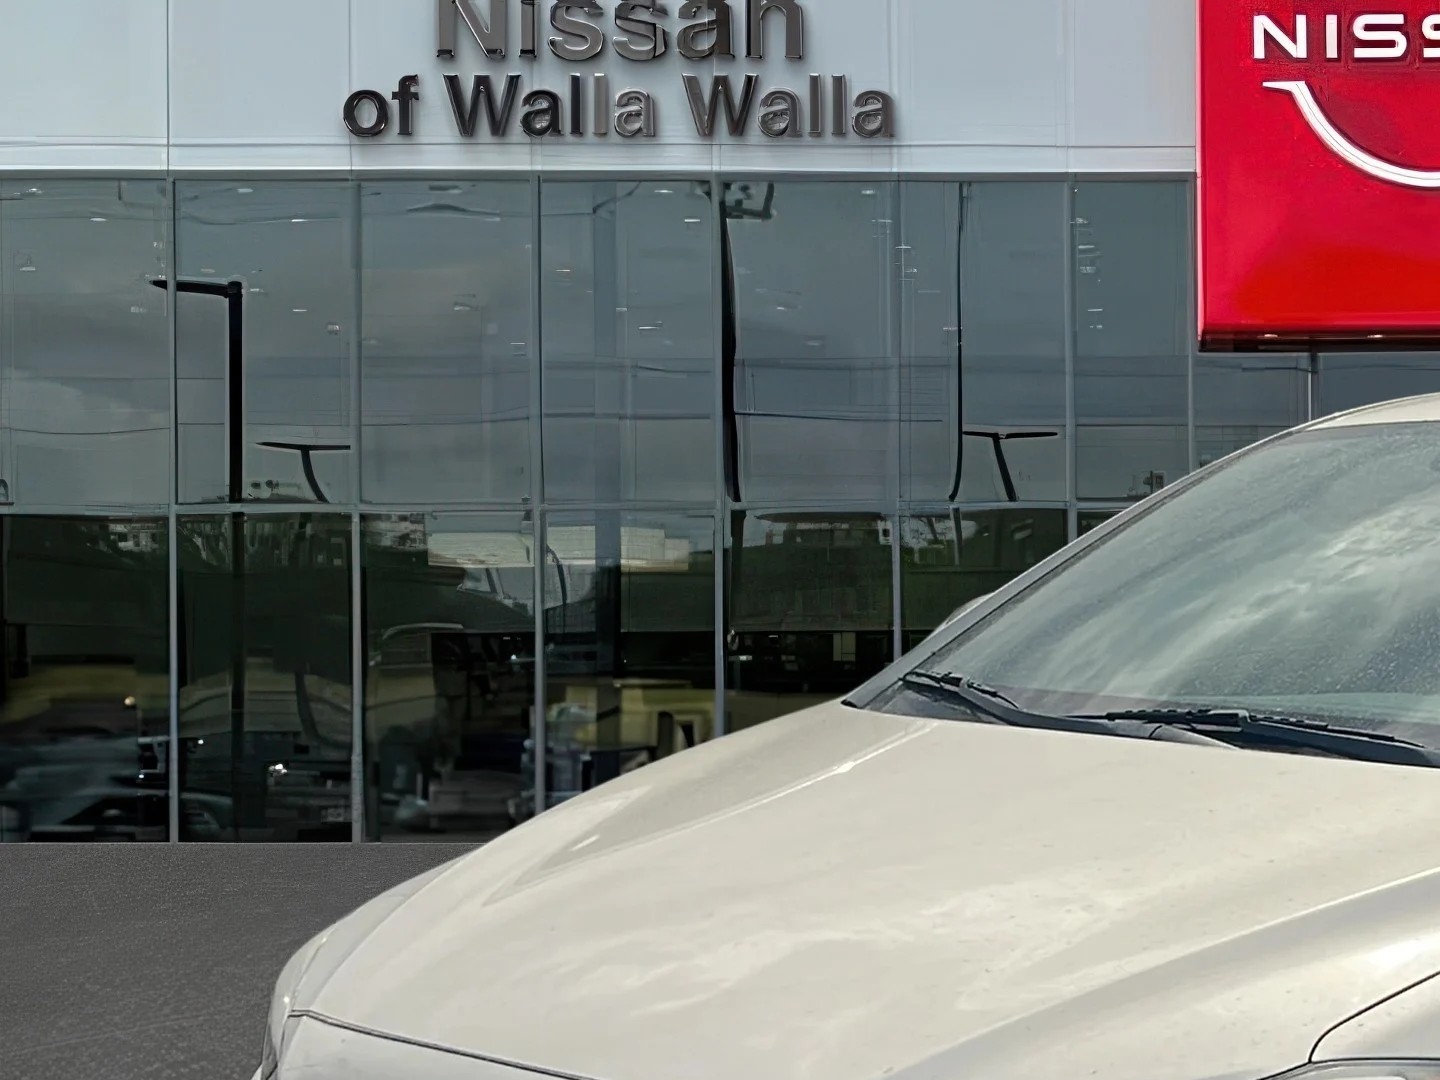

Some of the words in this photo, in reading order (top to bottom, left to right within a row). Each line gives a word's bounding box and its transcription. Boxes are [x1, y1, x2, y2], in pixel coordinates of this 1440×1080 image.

[437, 0, 804, 60] Nissan
[343, 74, 420, 137] of
[442, 73, 656, 138] Walla
[681, 73, 894, 138] Walla
